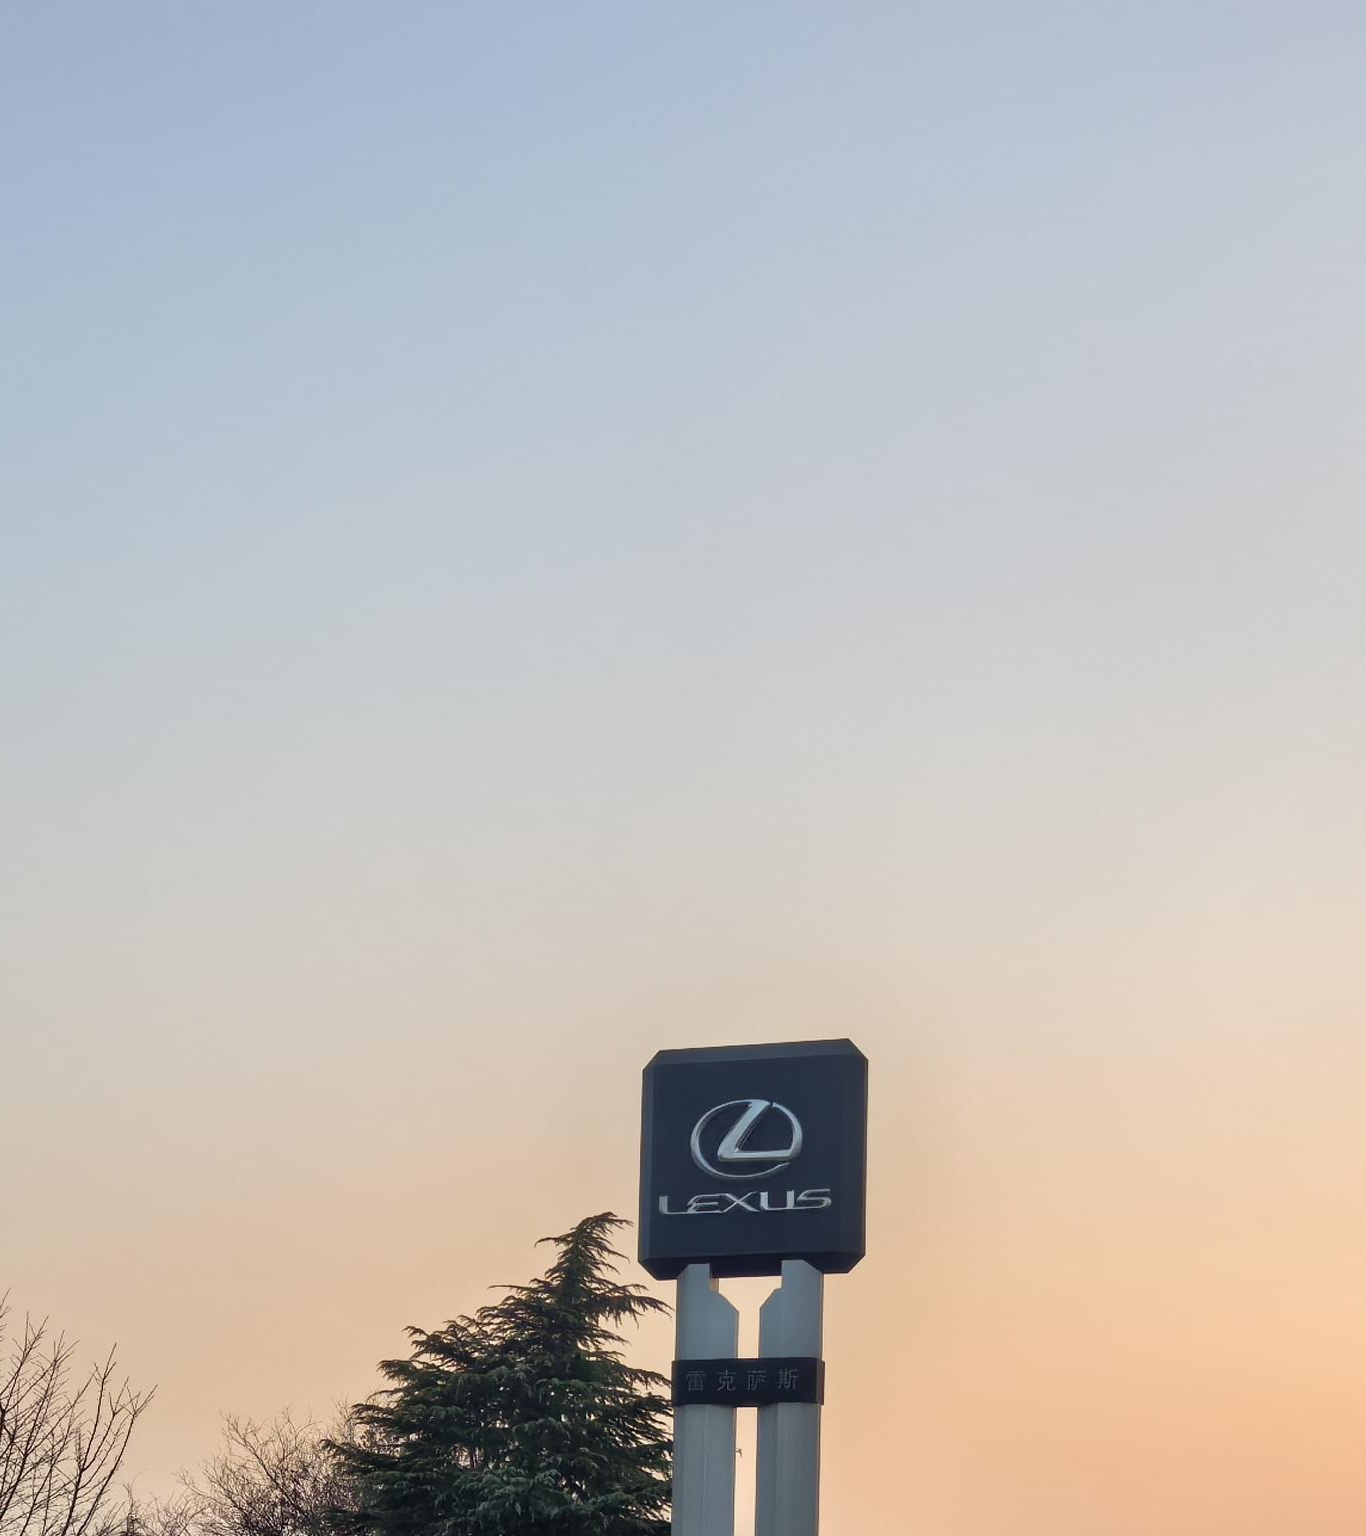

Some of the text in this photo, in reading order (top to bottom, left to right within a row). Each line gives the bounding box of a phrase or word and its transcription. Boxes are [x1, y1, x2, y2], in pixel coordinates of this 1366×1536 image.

[658, 1188, 832, 1216] LEXUS
[686, 1367, 800, 1392] 雷克萨斯
